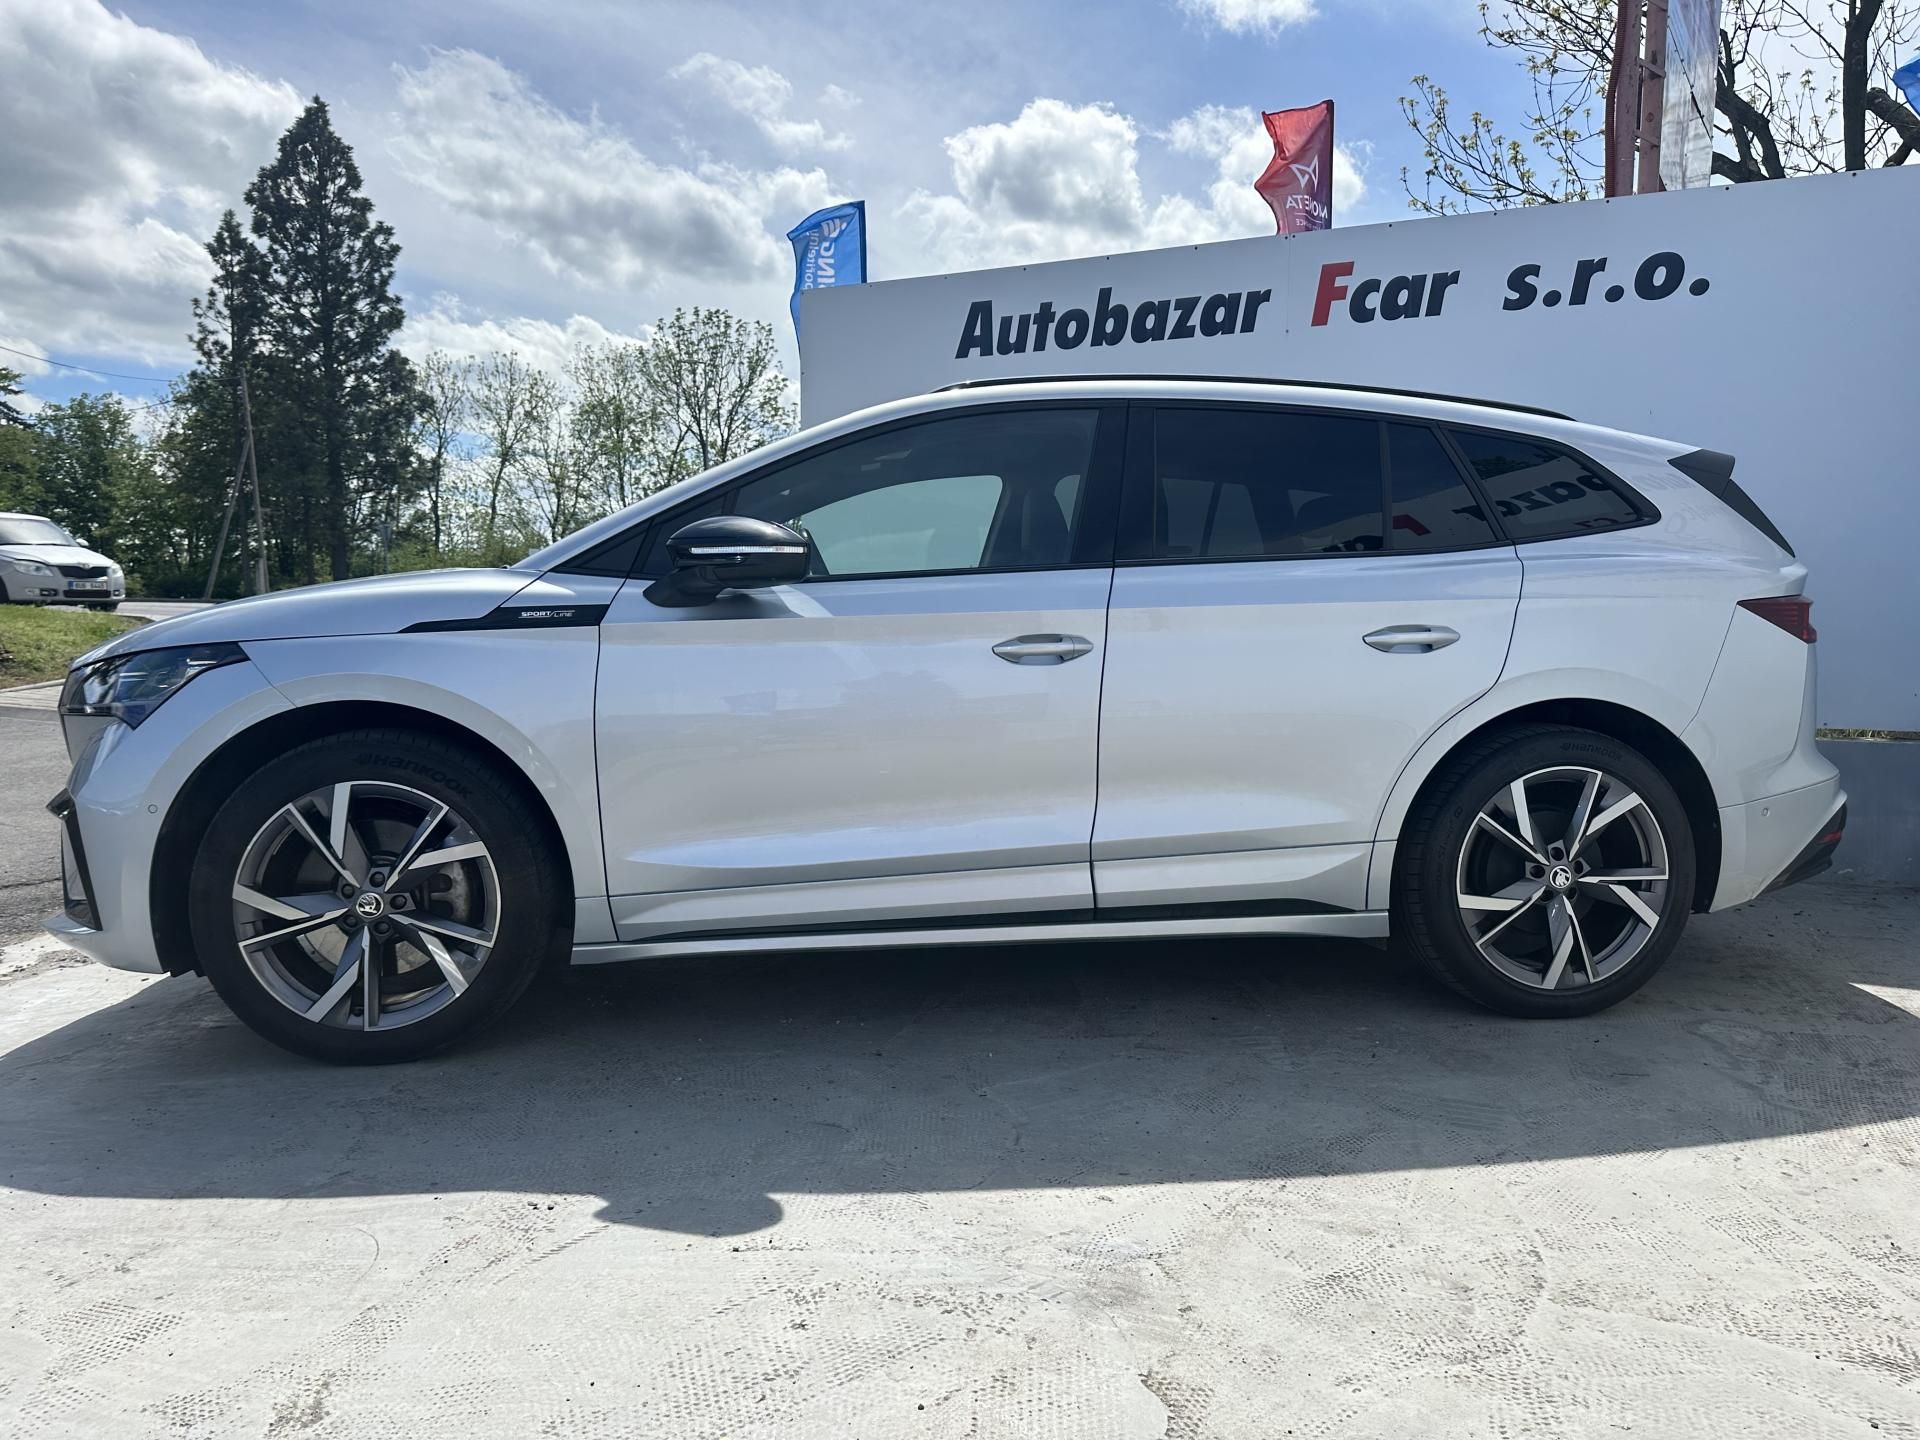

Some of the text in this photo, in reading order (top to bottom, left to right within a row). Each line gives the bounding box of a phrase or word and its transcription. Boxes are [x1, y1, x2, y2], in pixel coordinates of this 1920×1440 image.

[955, 252, 1709, 359] Autobazar Fcar s.r.o.
